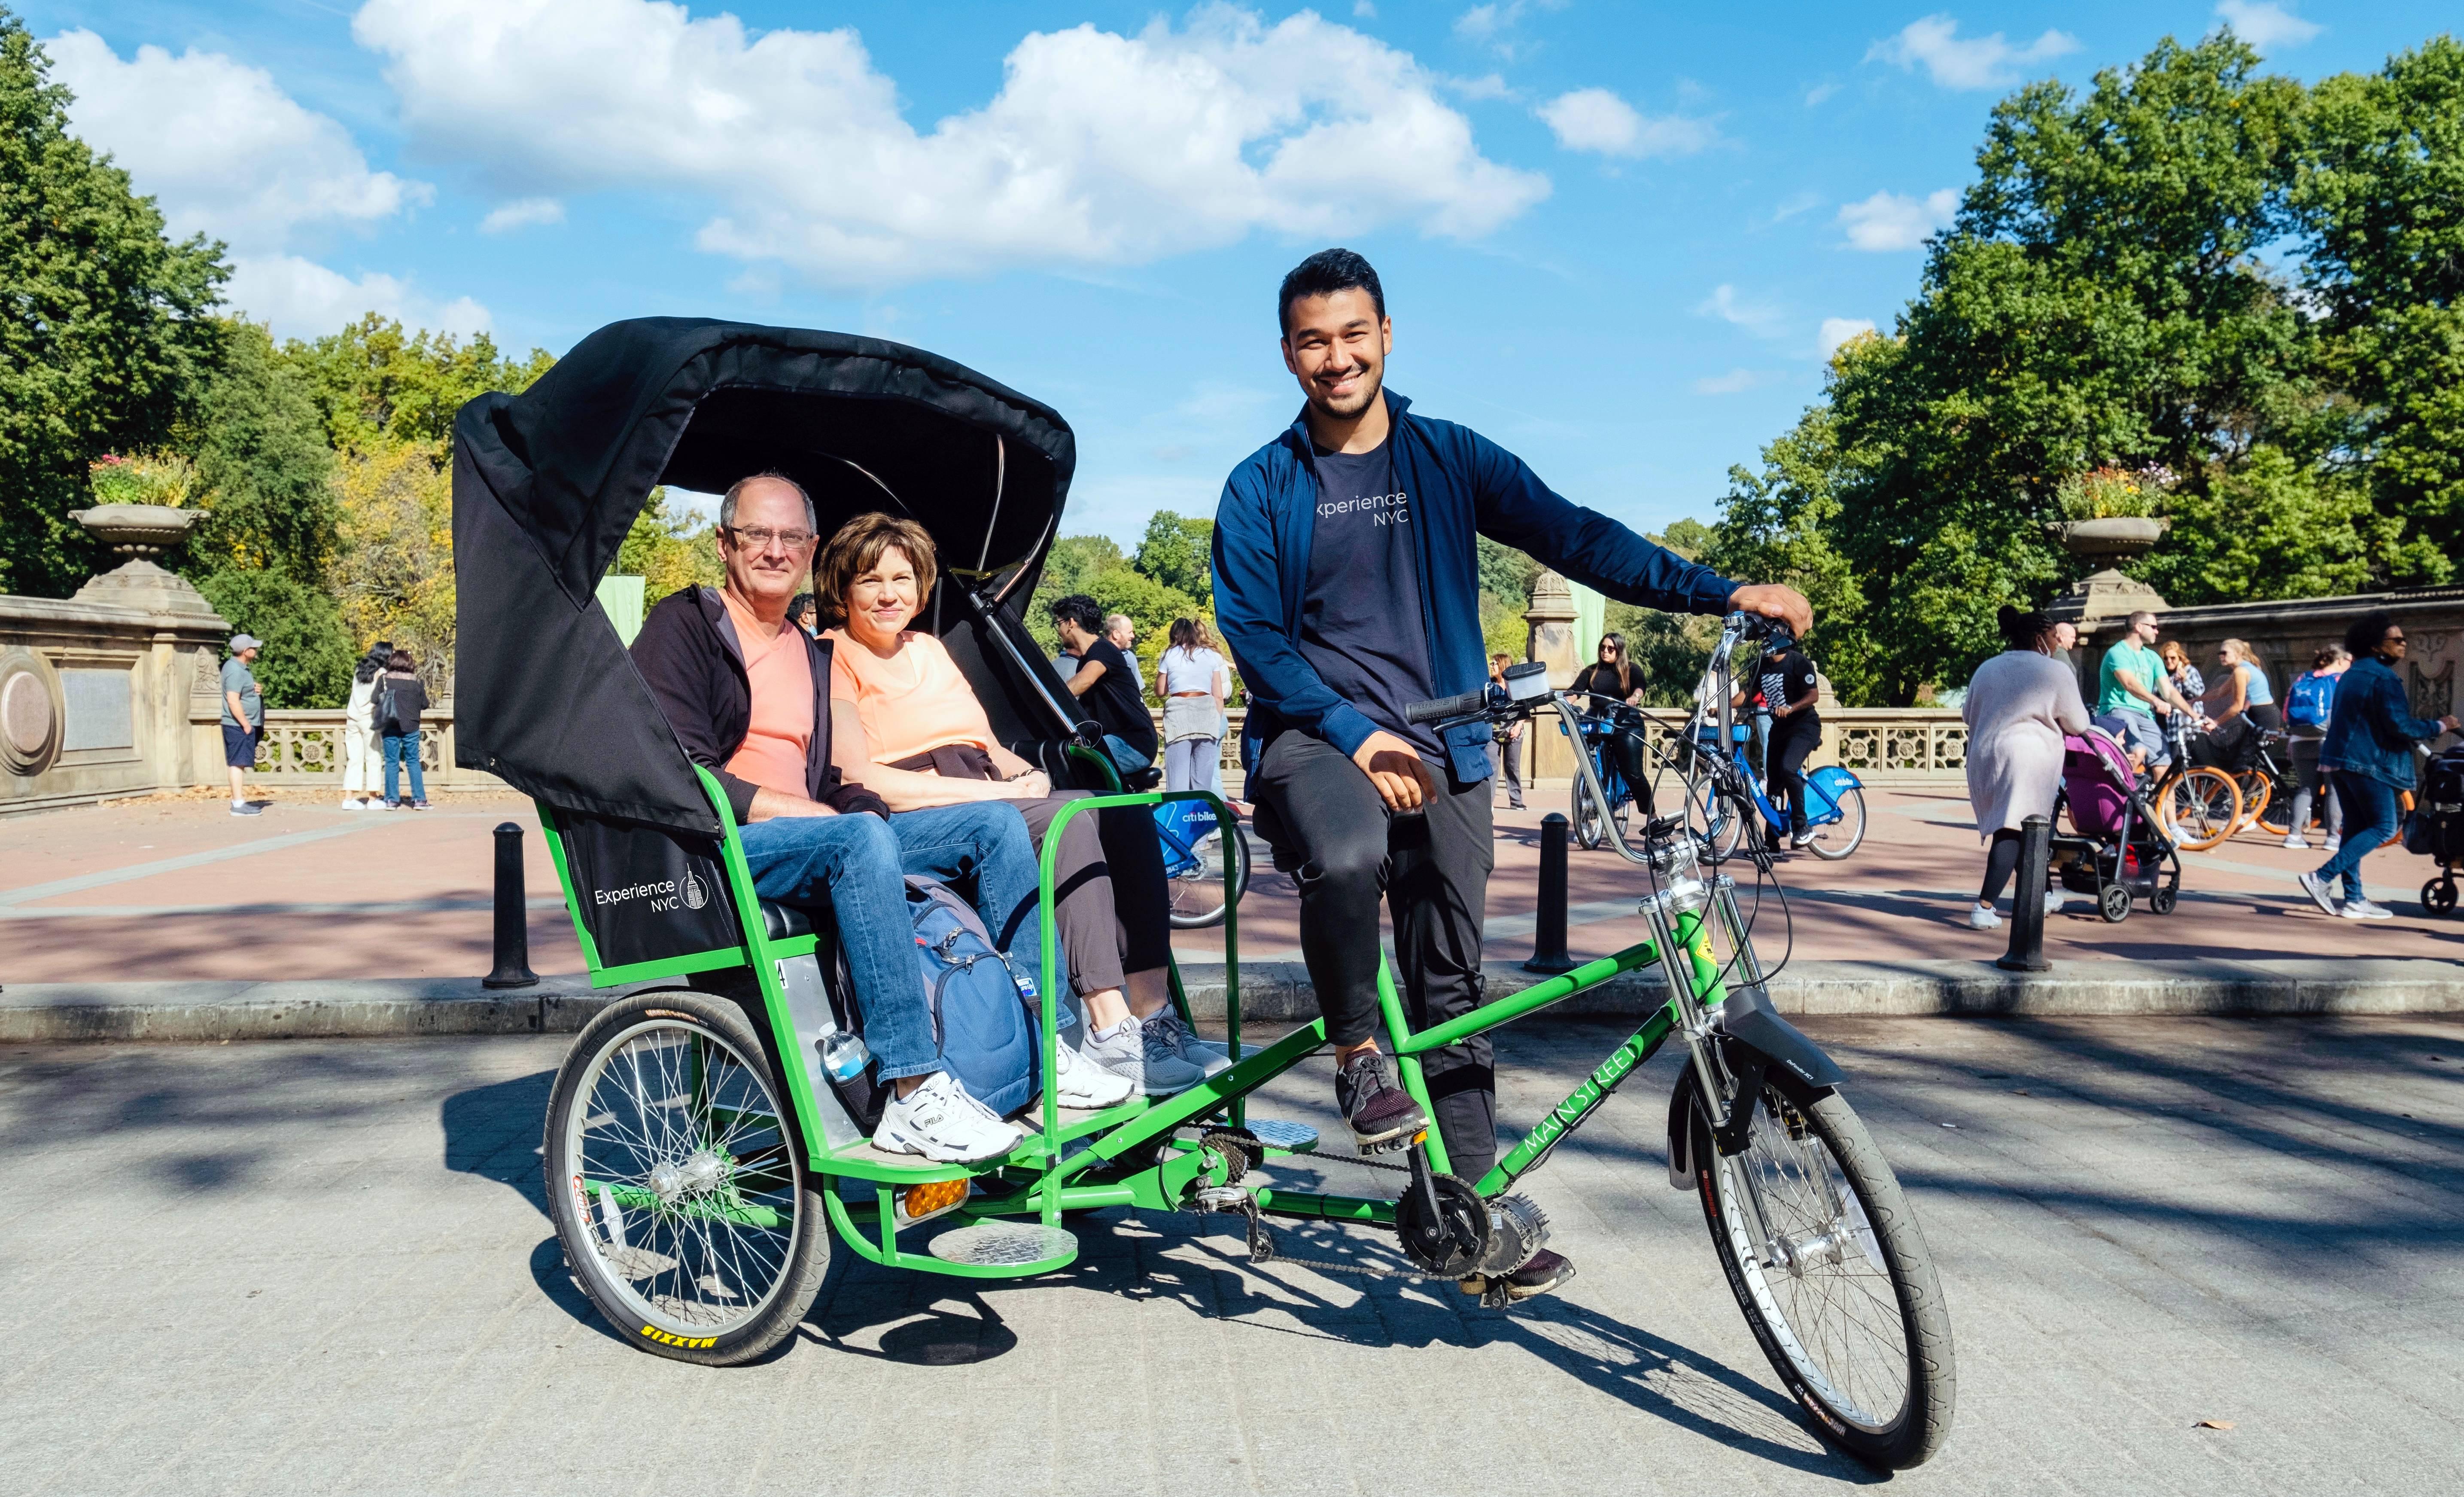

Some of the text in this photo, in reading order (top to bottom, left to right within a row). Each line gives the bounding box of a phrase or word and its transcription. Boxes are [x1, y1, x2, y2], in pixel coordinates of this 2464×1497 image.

[1317, 492, 1407, 518] xperience
[1374, 509, 1408, 527] NYC
[1418, 710, 1452, 720] SRAM
[1182, 811, 1217, 822] citi bike
[595, 881, 675, 905] Experience
[651, 896, 679, 913] NYC
[1524, 1039, 1636, 1155] MAIN STREET
[924, 1114, 944, 1128] FILA
[641, 1325, 718, 1348] MAXXIS
